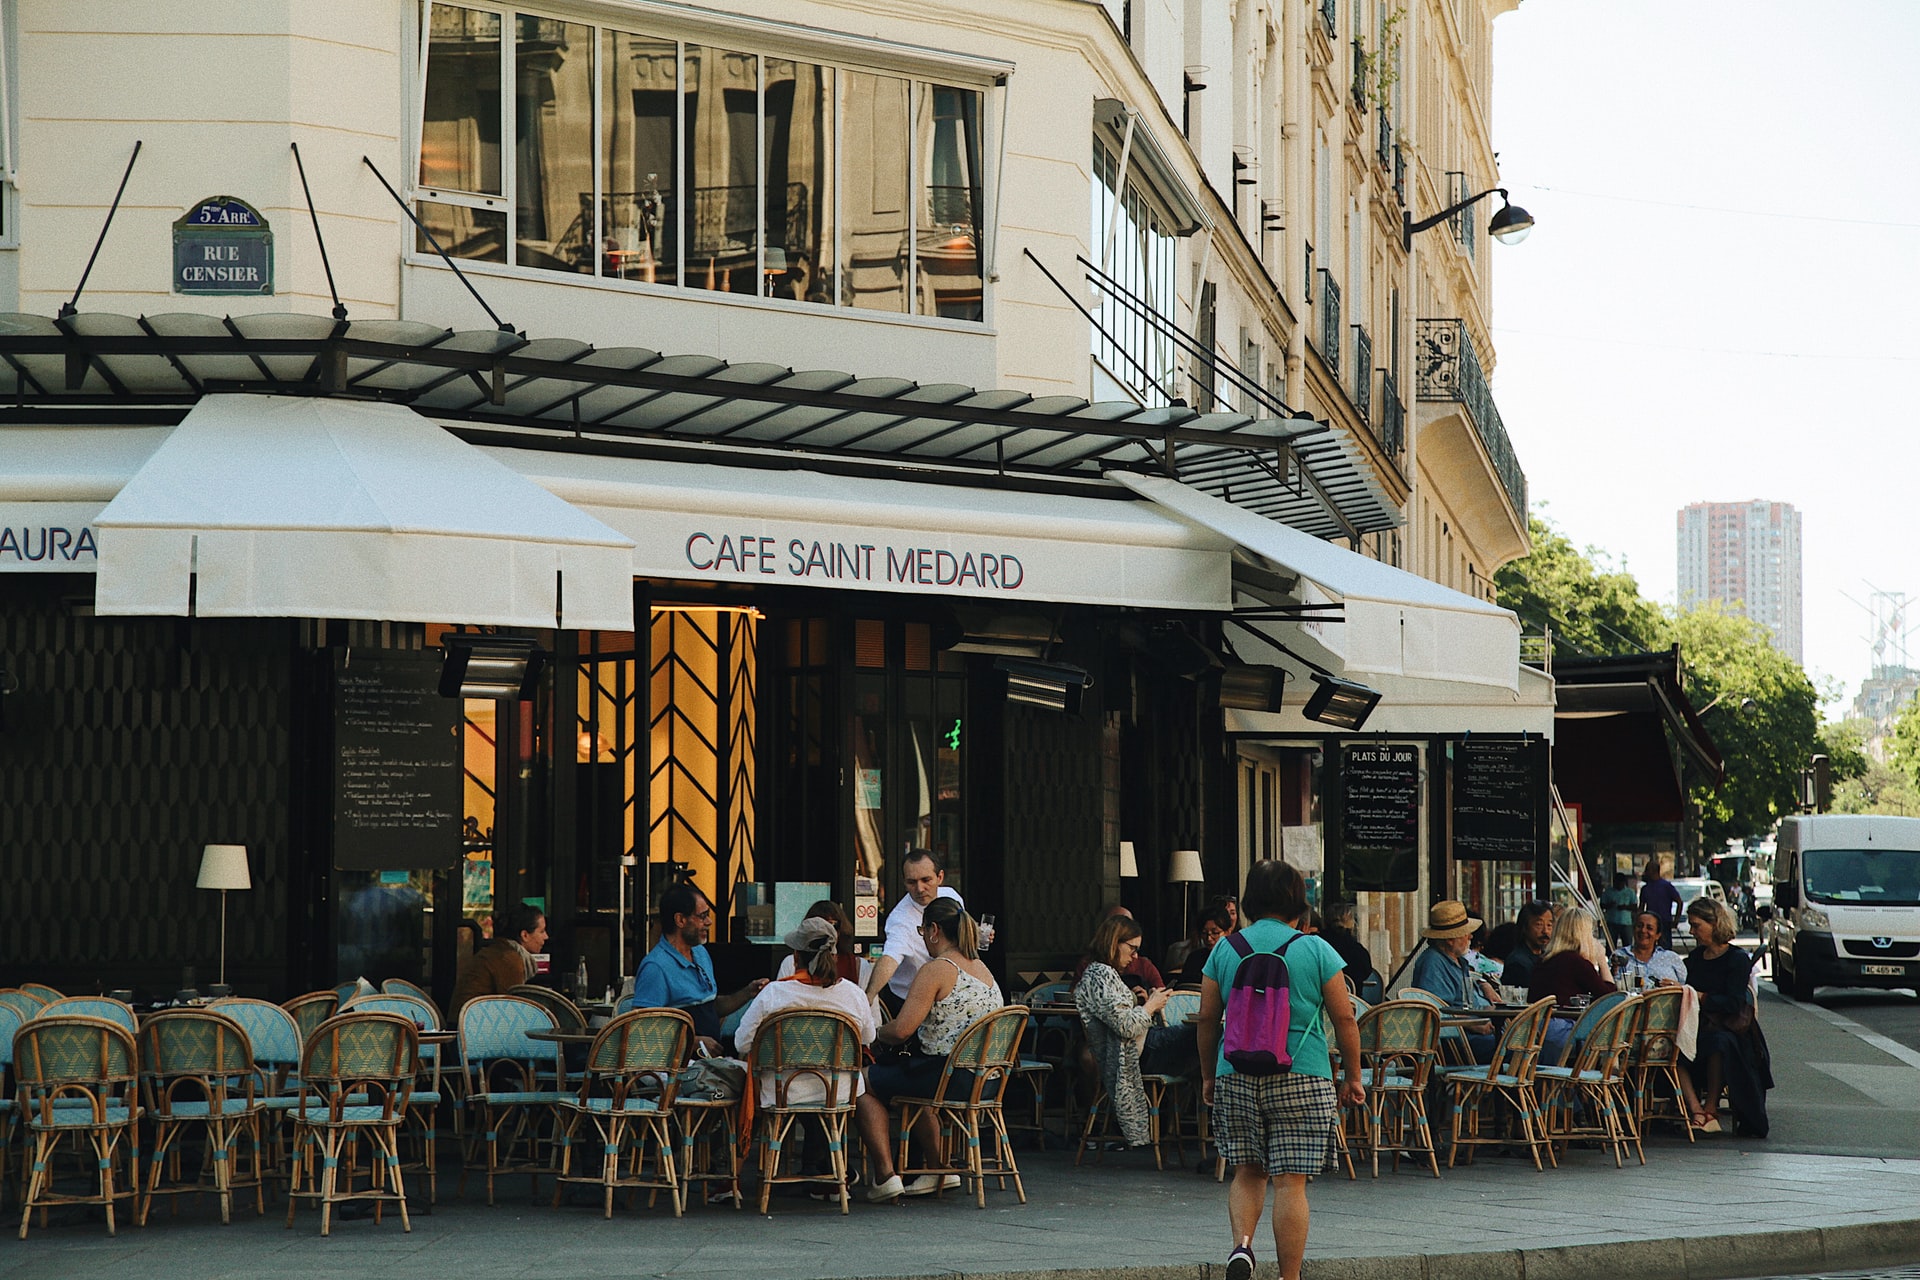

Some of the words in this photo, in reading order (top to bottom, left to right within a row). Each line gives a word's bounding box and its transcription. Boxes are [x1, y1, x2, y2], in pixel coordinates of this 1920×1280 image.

[204, 246, 239, 260] RUE
[182, 267, 259, 281] CENSIER
[0, 527, 98, 561] AURA
[685, 531, 776, 574] CAFE
[788, 538, 875, 580] SAINT
[887, 546, 1024, 590] MEDARD
[1352, 751, 1377, 762] PLATS
[1379, 752, 1391, 762] DU
[1392, 752, 1413, 762] JOUR
